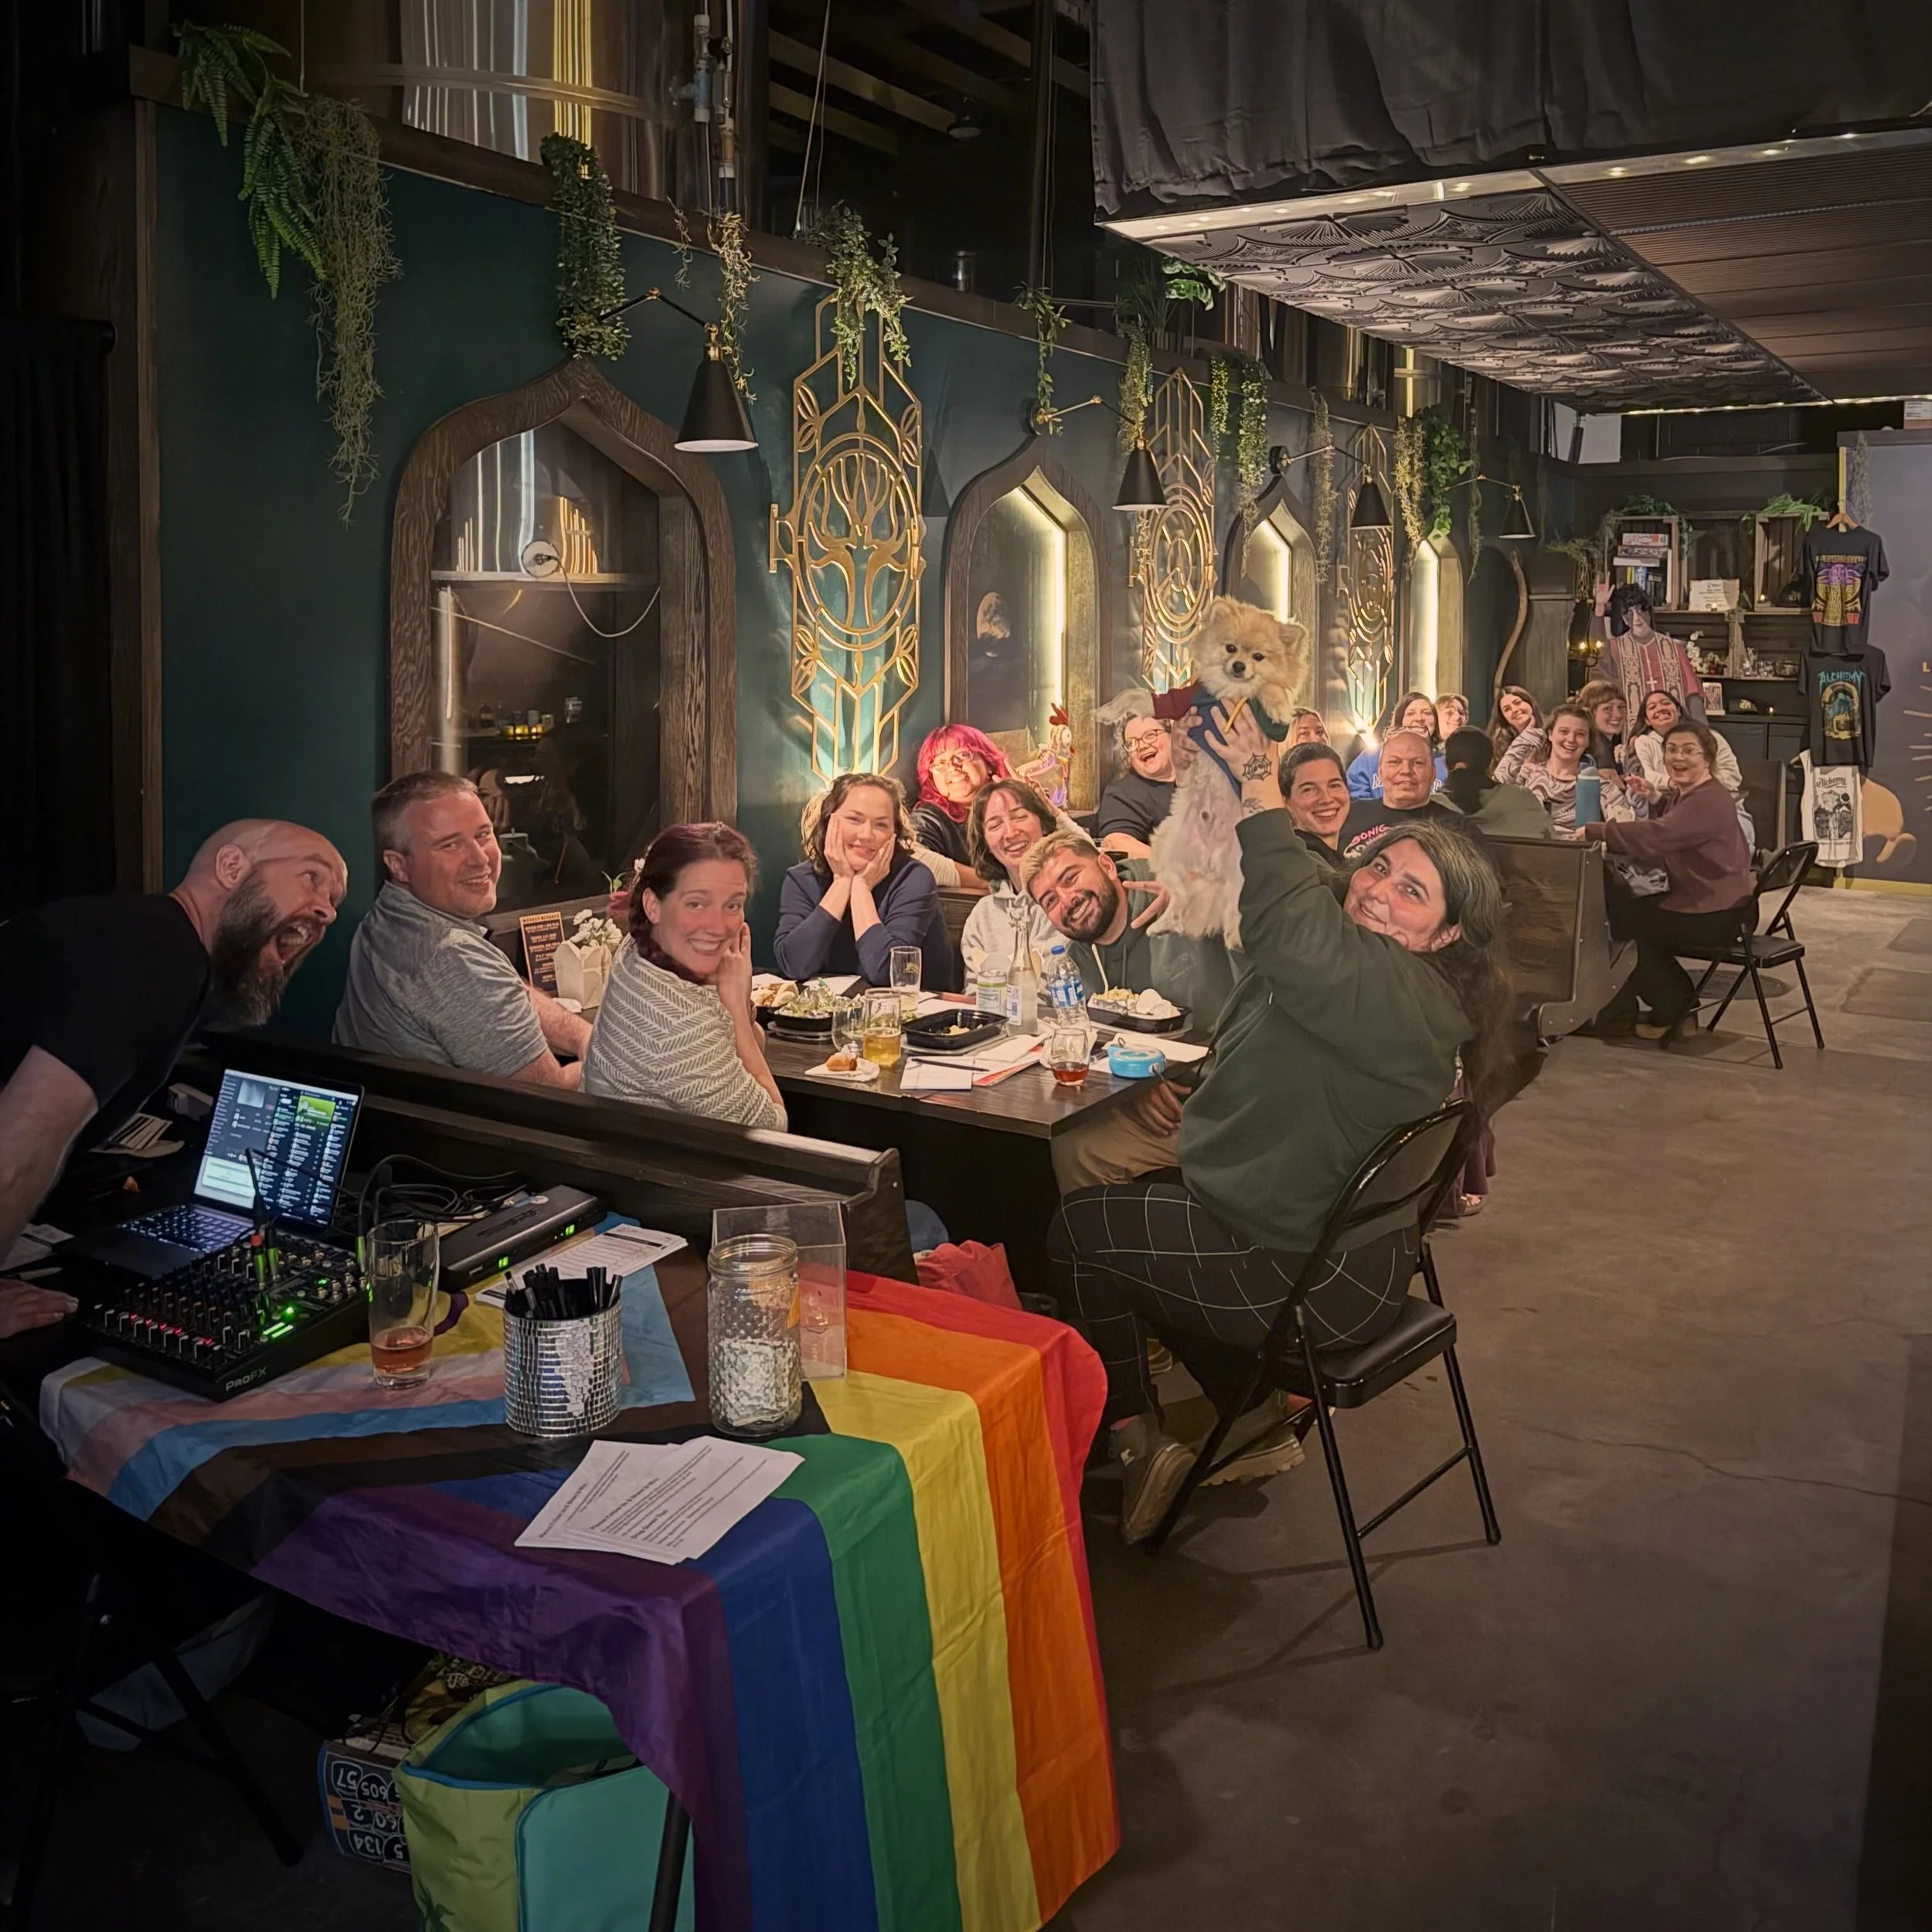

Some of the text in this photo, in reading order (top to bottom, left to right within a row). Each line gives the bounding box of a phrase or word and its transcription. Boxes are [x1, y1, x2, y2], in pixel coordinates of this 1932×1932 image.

[1818, 669, 1866, 689] ALCHEMY
[1816, 777, 1847, 788] Alchemy
[336, 1768, 358, 1790] 57
[361, 1781, 388, 1800] 605
[351, 1804, 365, 1821] 2
[376, 1812, 397, 1830] 60
[354, 1832, 382, 1855] 134
